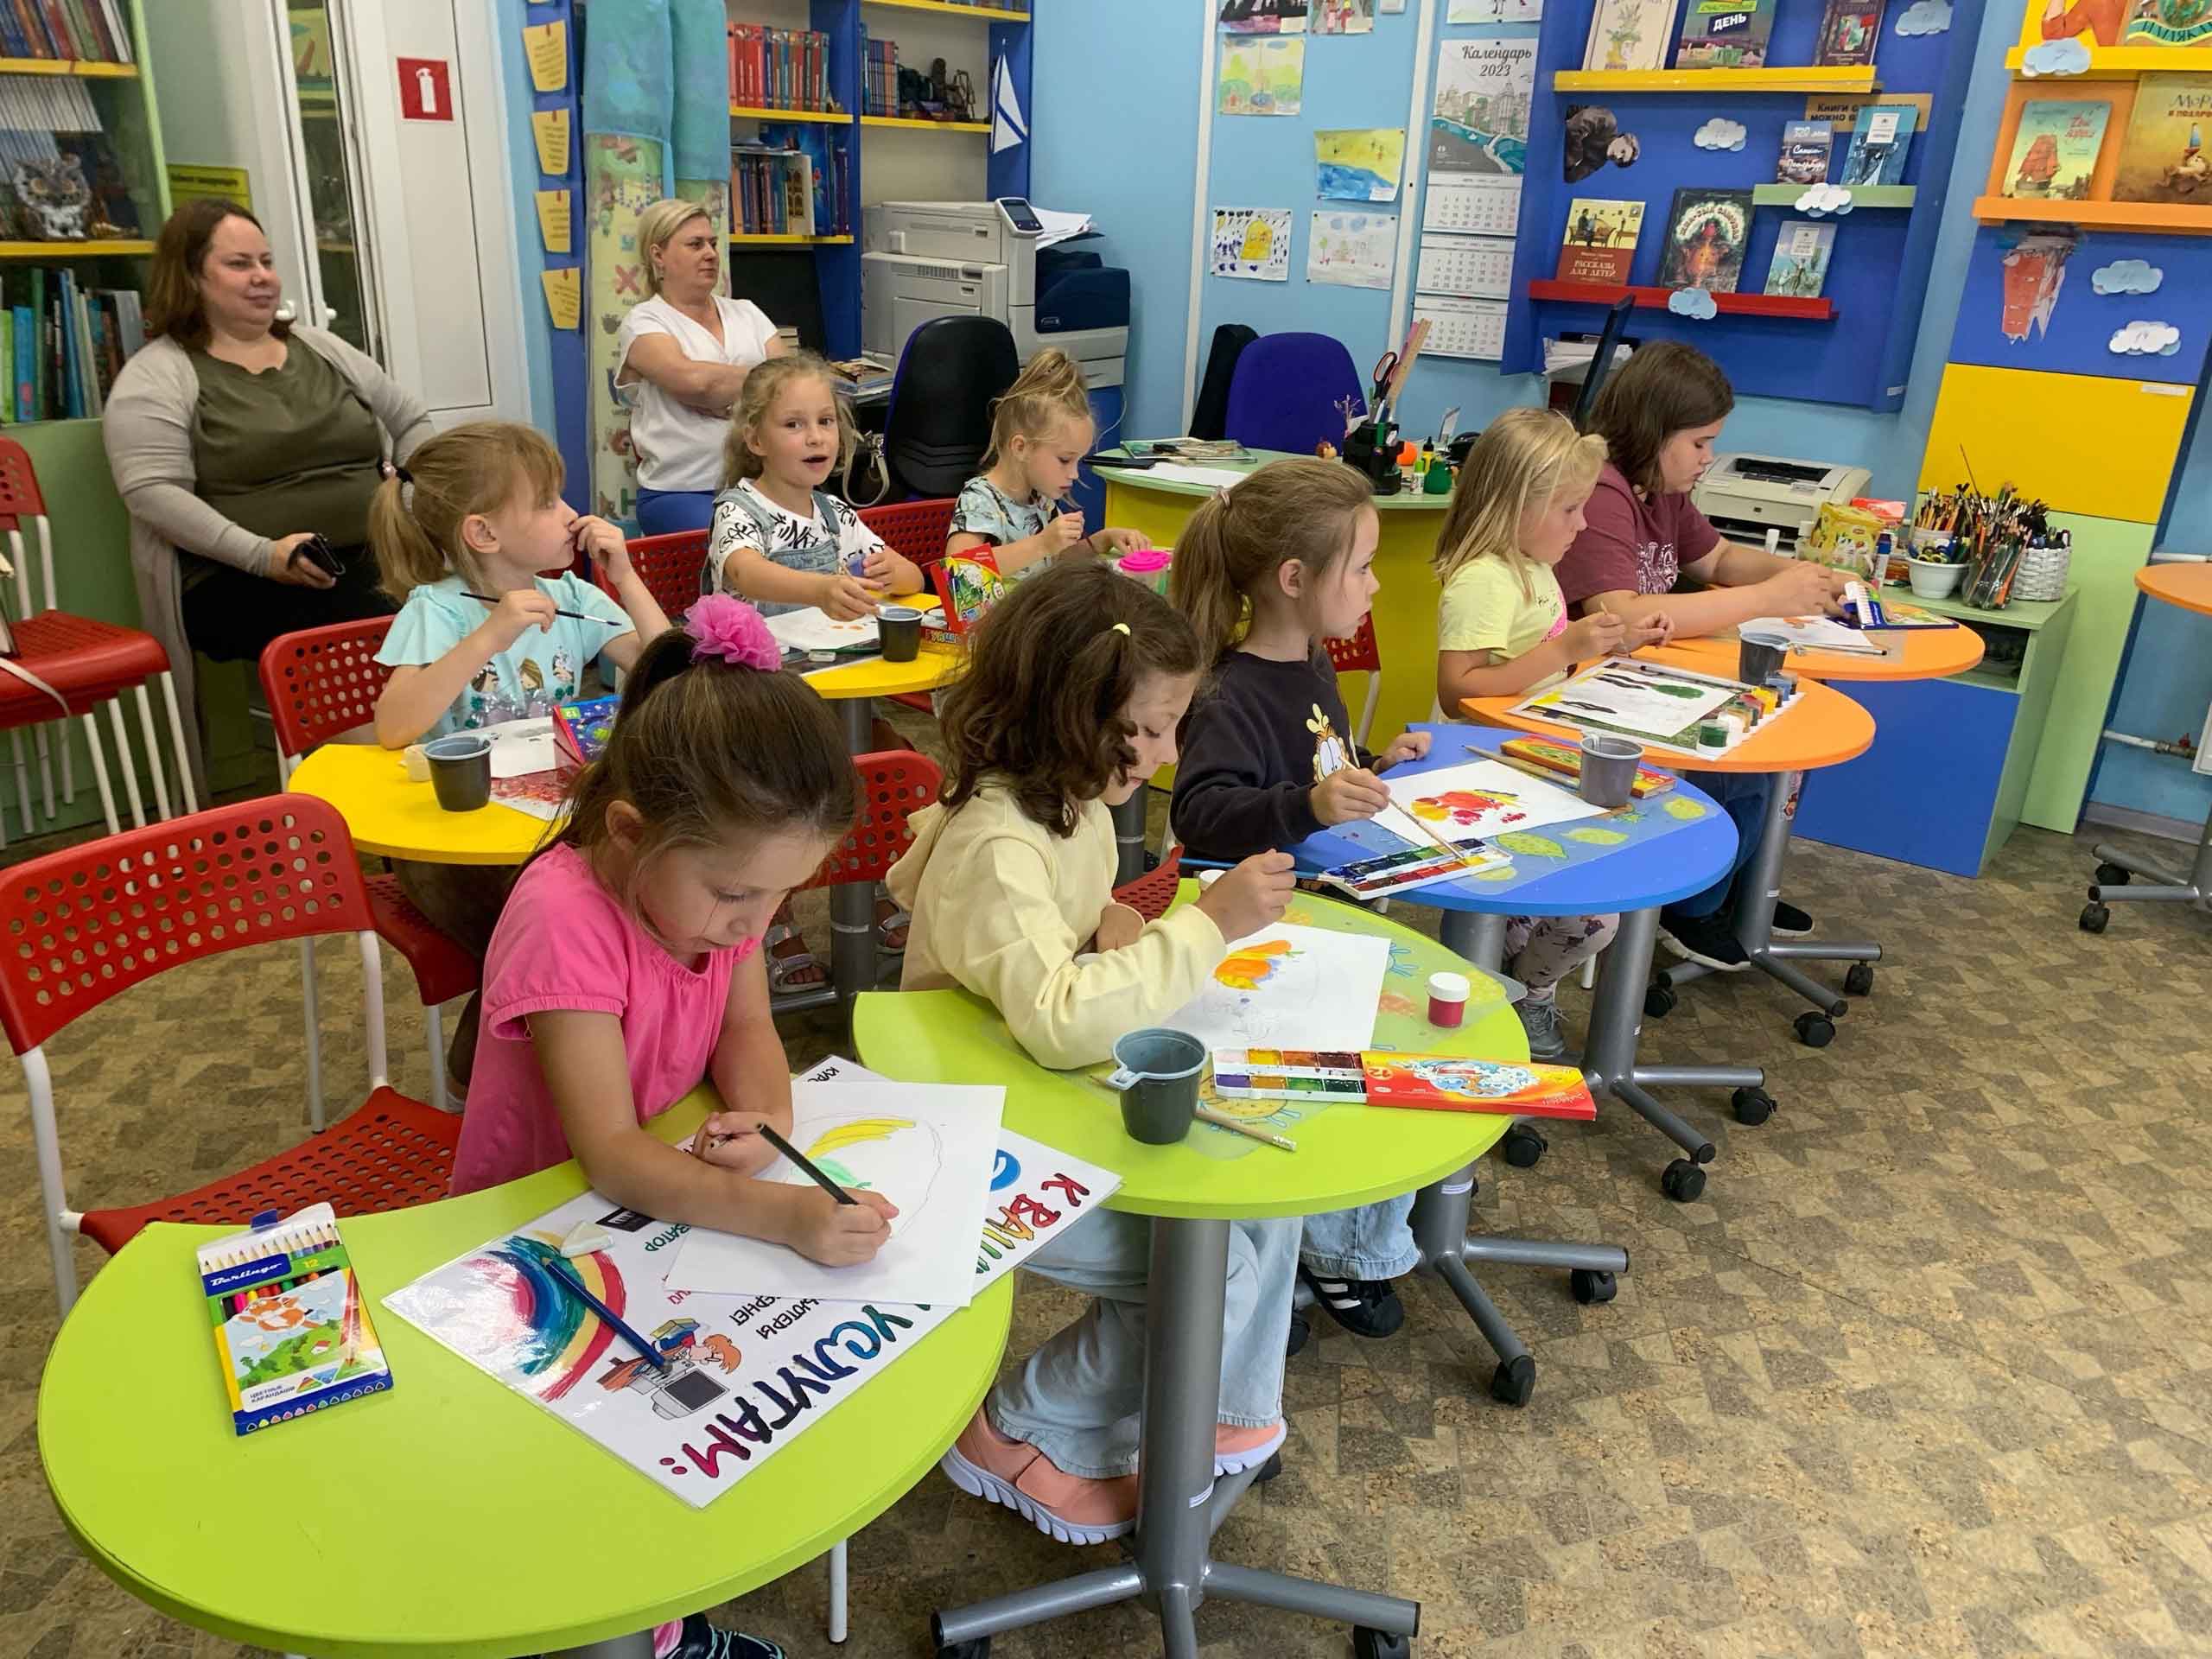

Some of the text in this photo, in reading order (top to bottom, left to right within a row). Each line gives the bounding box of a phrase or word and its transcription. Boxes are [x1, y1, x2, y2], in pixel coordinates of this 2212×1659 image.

[1713, 13, 1747, 32] ДЕНЬ
[1461, 45, 1533, 65] Календарь
[1479, 64, 1511, 77] 2023
[1817, 103, 1848, 112] Книги
[1040, 1172, 1090, 1207] К
[210, 1262, 283, 1287] Berlingo
[659, 1304, 913, 1478] УСЛУГАМ:
